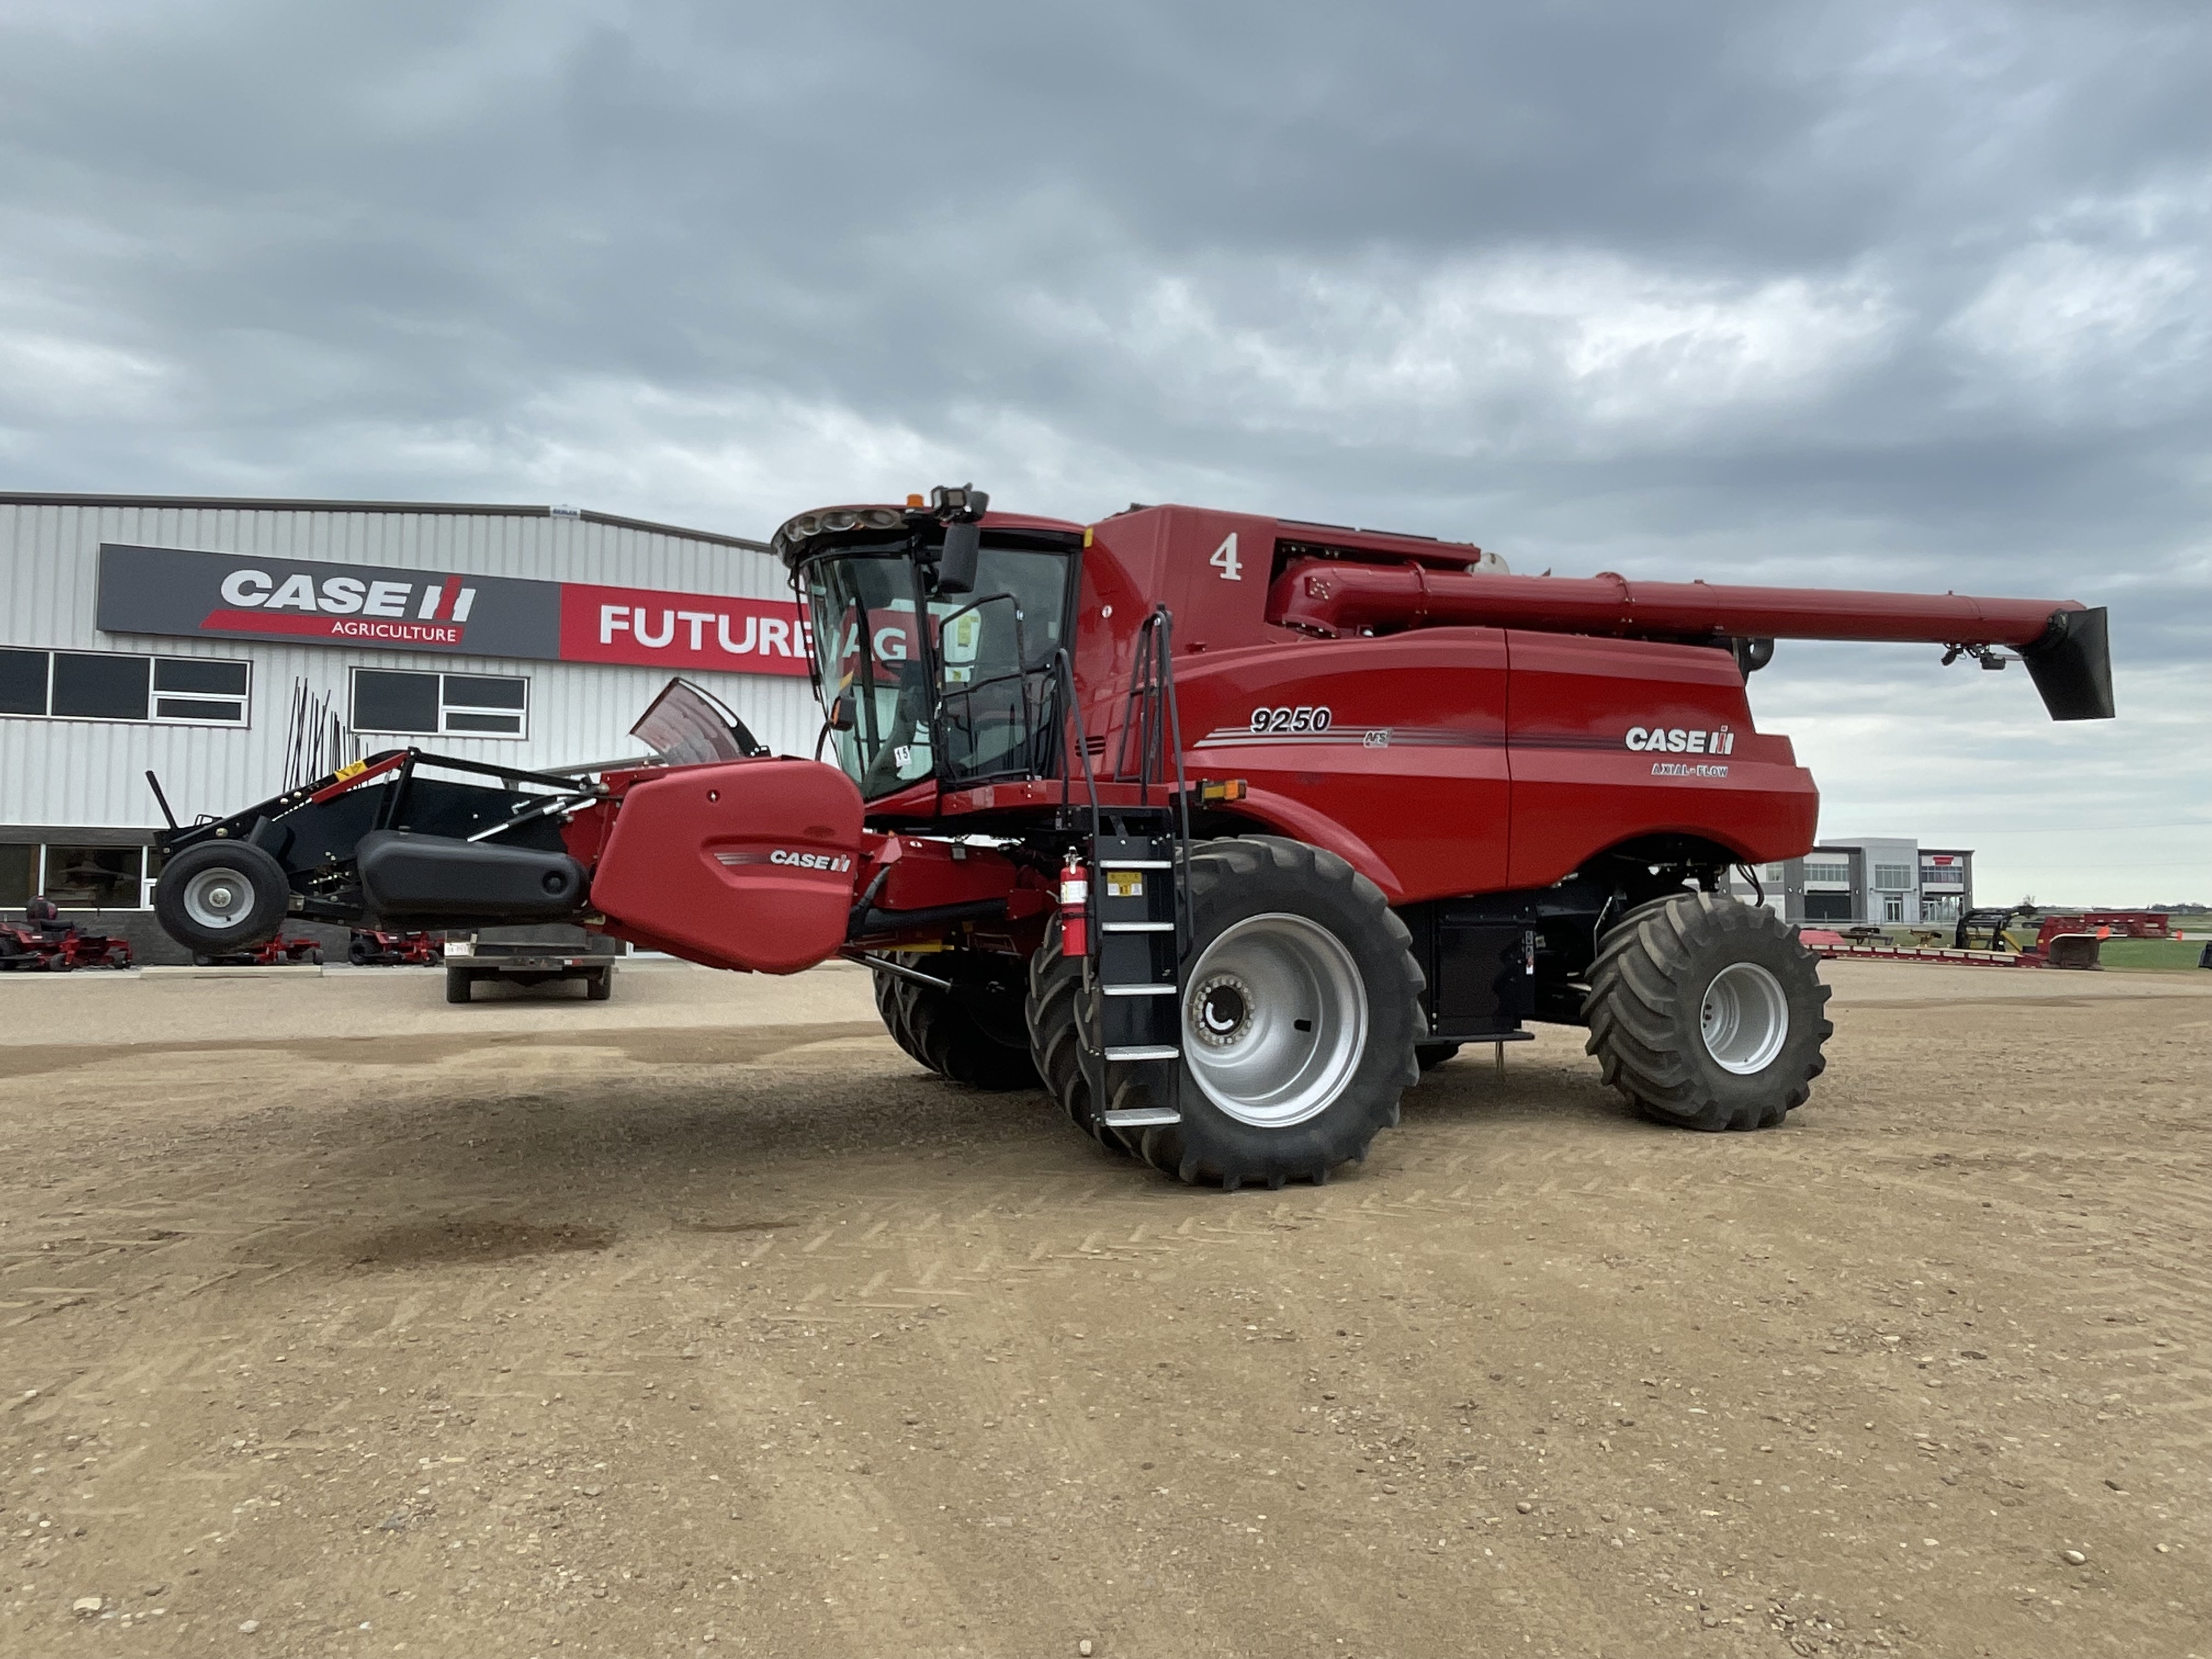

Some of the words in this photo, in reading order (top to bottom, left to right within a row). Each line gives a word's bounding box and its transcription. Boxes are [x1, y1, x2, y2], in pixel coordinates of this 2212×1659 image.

[1209, 532, 1243, 580] 4
[221, 569, 412, 618] CASE
[417, 575, 476, 622] IH
[331, 621, 456, 642] AGRICULTURE
[600, 605, 814, 659] FUTURE
[1250, 706, 1333, 733] 9250
[1625, 726, 1707, 753] CASE
[896, 747, 909, 761] 15
[770, 850, 830, 870] CASE
